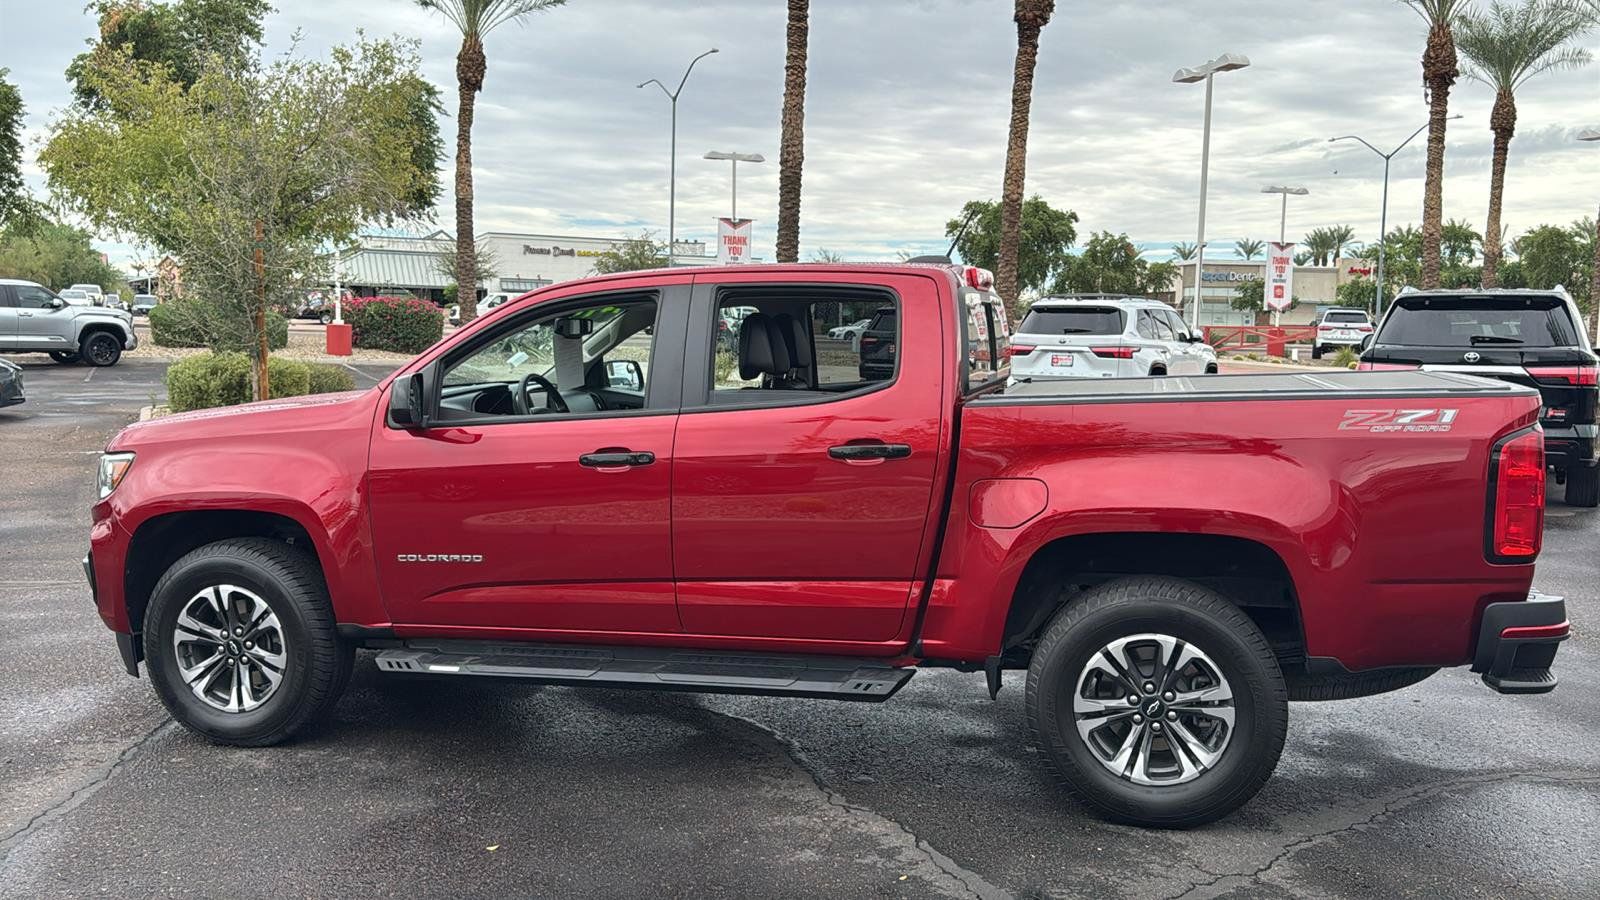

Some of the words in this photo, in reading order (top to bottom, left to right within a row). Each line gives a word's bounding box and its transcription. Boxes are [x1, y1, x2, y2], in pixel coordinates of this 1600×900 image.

[723, 235, 748, 246] THANK
[728, 246, 743, 256] YOU
[1272, 256, 1290, 265] THANK
[1275, 265, 1286, 274] YOU
[1338, 408, 1460, 431] Z71
[1370, 425, 1402, 433] OFF
[397, 553, 483, 563] COLORADO
